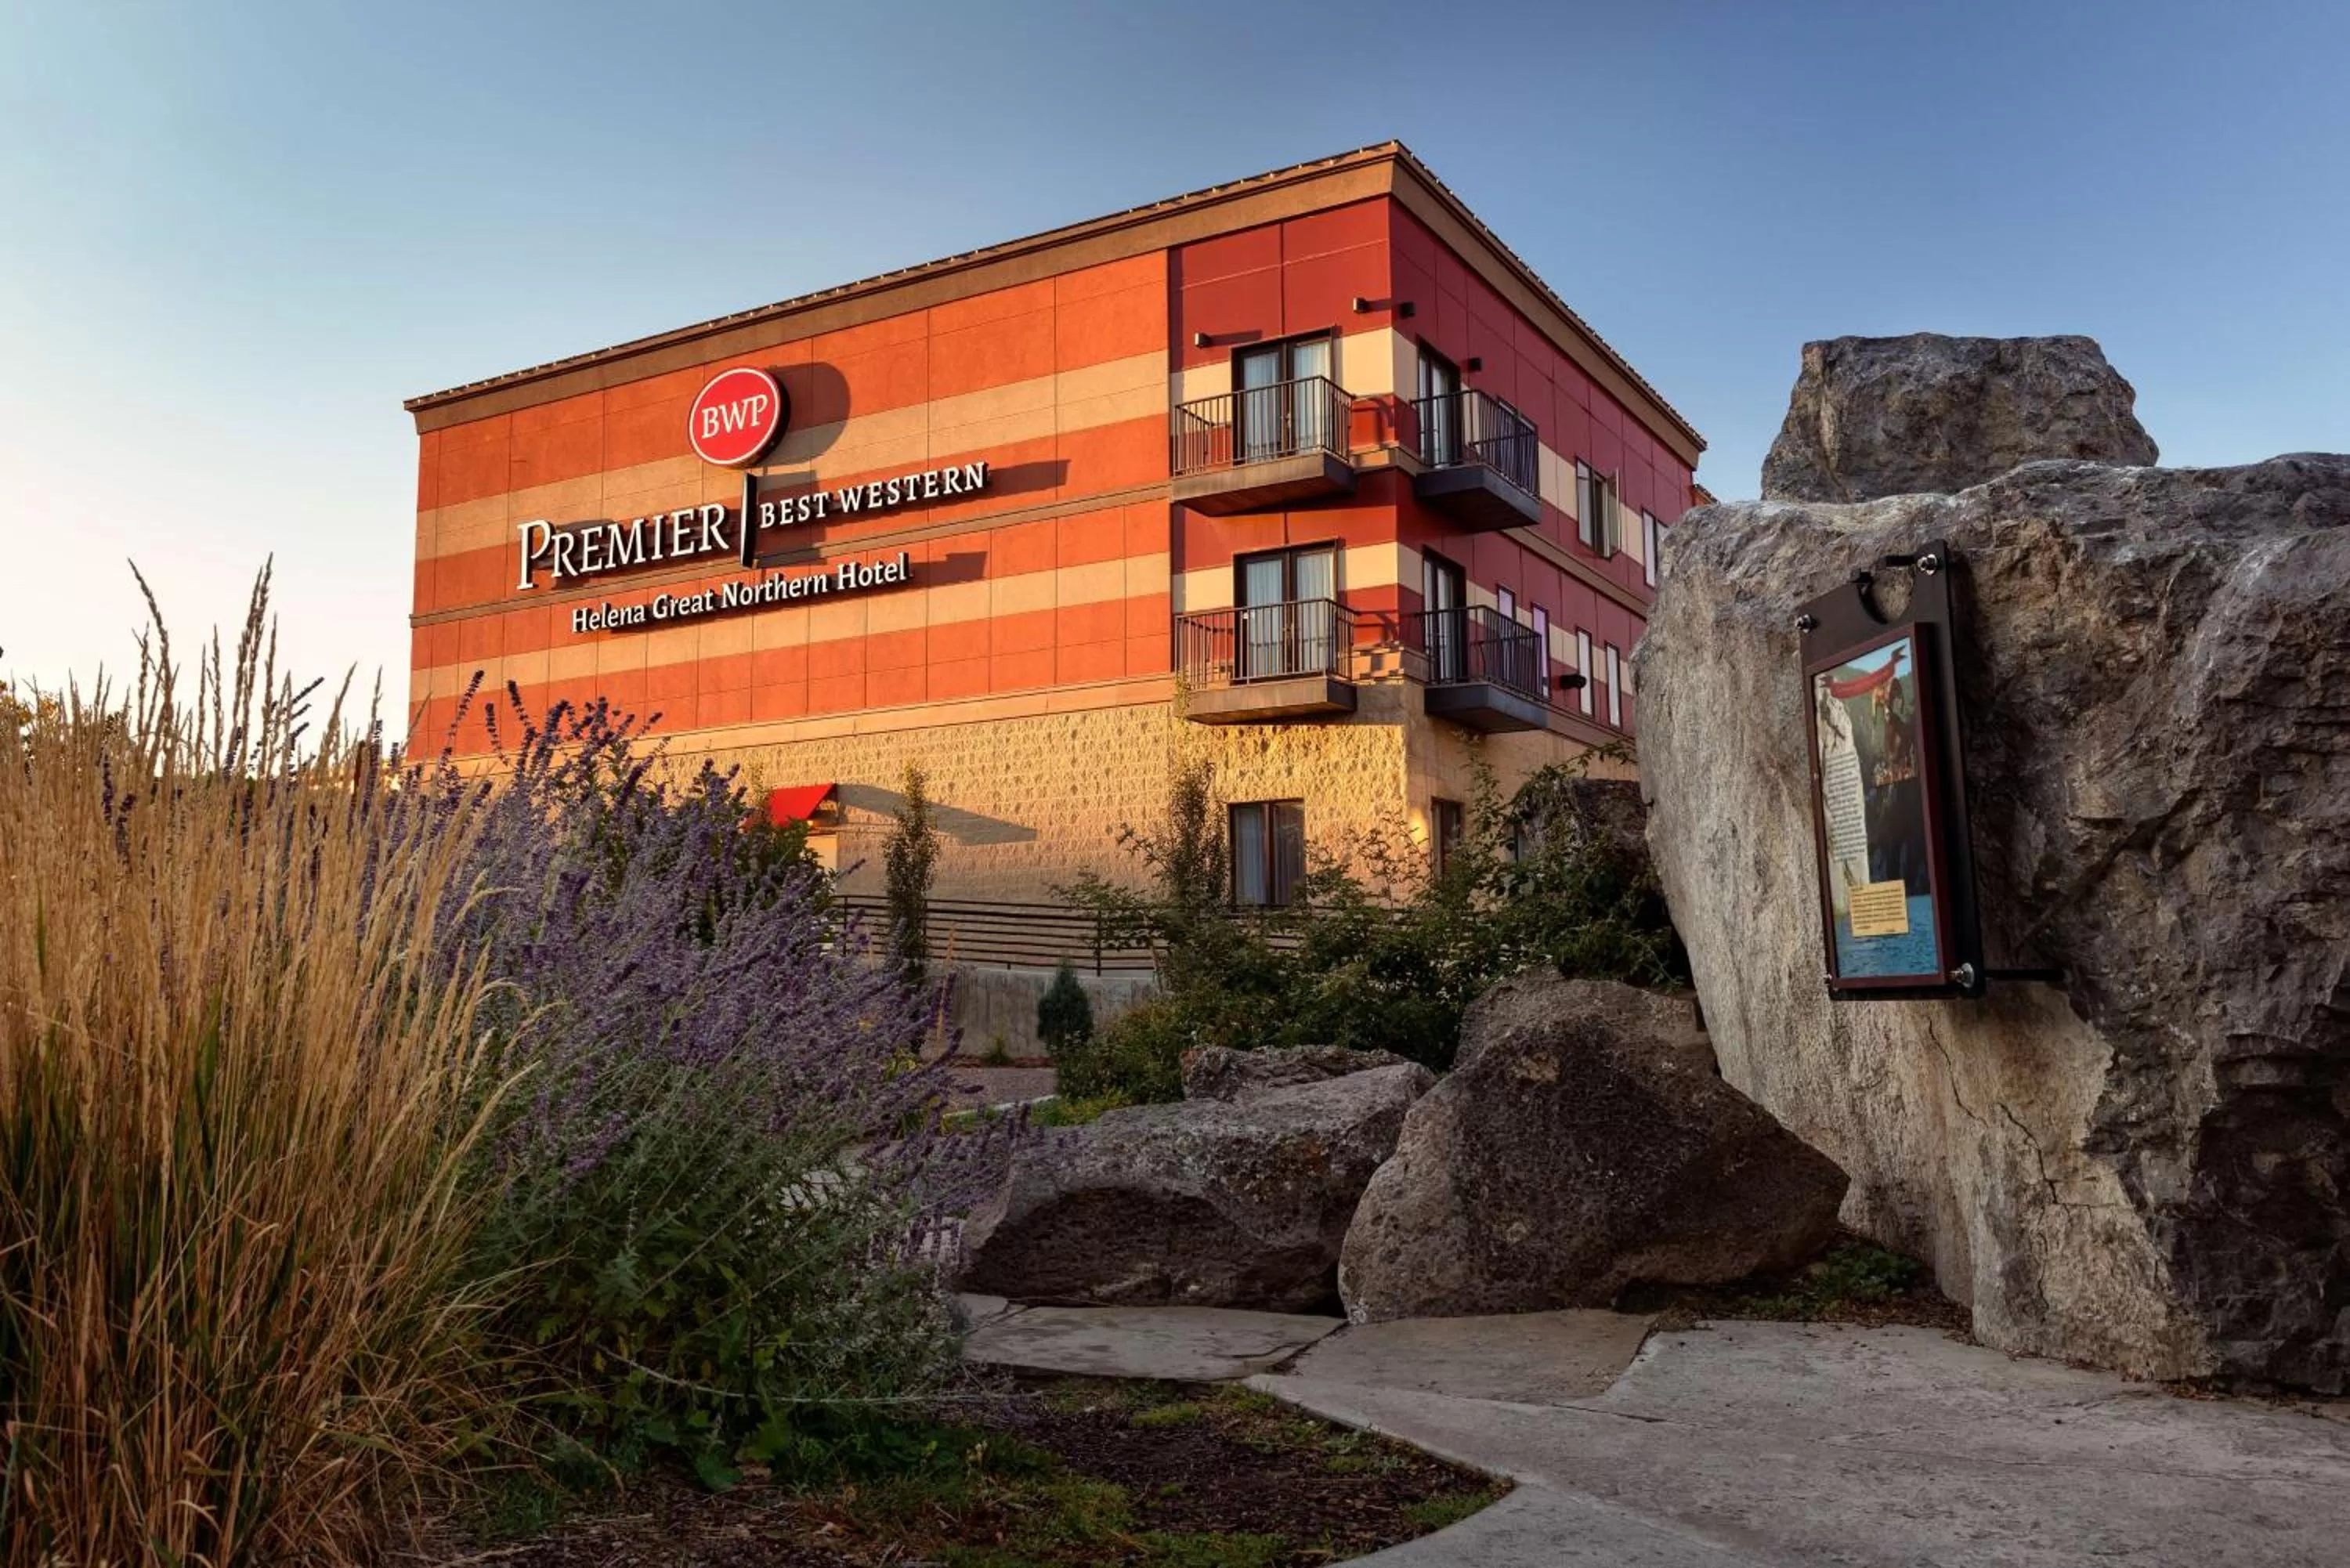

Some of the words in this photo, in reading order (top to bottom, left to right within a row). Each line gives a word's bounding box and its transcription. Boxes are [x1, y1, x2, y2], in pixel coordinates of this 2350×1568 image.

[700, 393, 768, 439] BWP
[760, 491, 830, 529] BEST
[838, 461, 989, 513] WESTERN
[516, 502, 729, 590] PREMIER
[571, 602, 645, 633] Helena
[652, 588, 714, 619] Great
[721, 573, 828, 608] Northern
[836, 551, 907, 591] Hotel
